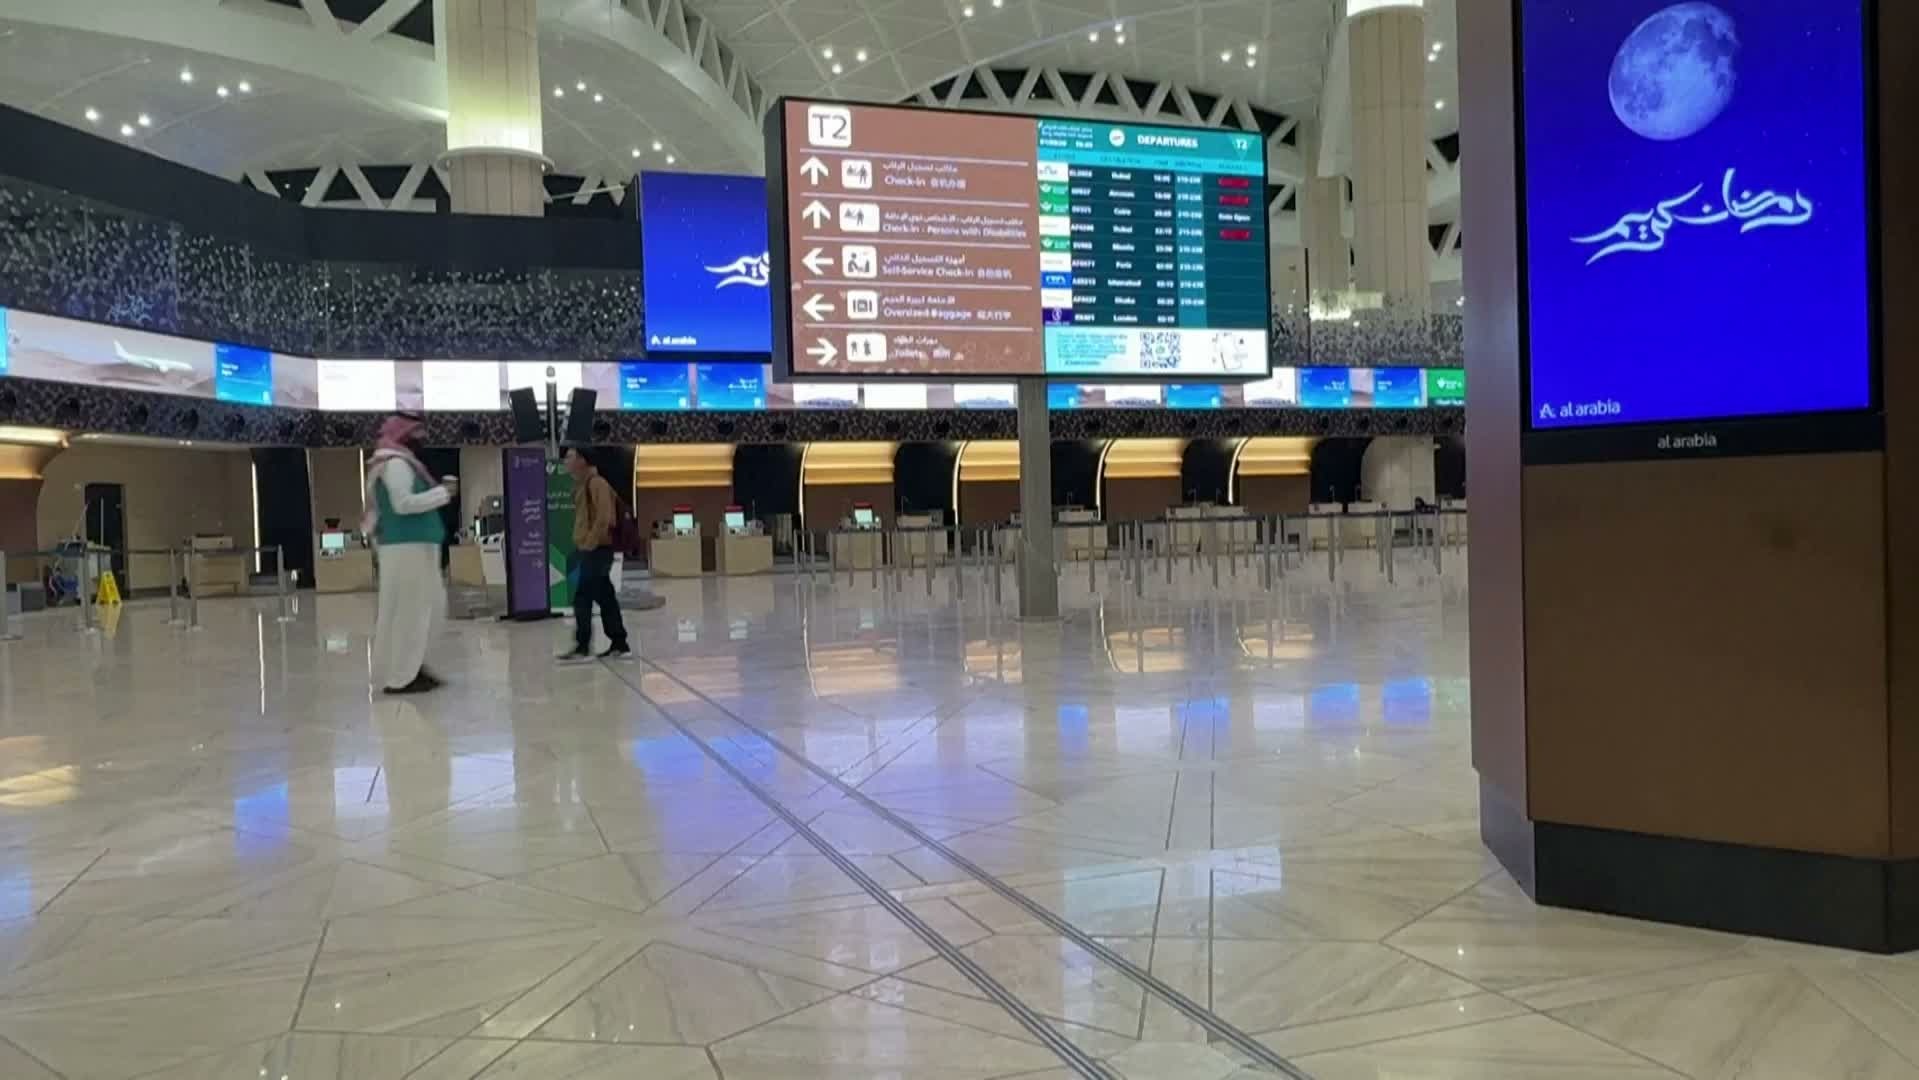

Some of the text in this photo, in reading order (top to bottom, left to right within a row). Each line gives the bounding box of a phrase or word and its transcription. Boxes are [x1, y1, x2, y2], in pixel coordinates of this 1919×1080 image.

[812, 114, 847, 140] T2
[1137, 135, 1198, 148] DEPARTURES
[884, 175, 926, 187] Check-in
[1569, 168, 1812, 266] رمضان كريم
[883, 223, 920, 233] Check-in
[961, 226, 981, 236] with
[882, 265, 933, 276] Self-Service
[935, 267, 974, 278] Check-in
[883, 307, 929, 318] Oversized
[931, 309, 972, 320] Baggage
[1559, 398, 1621, 417] al arabia
[1657, 432, 1717, 449] al arabia
